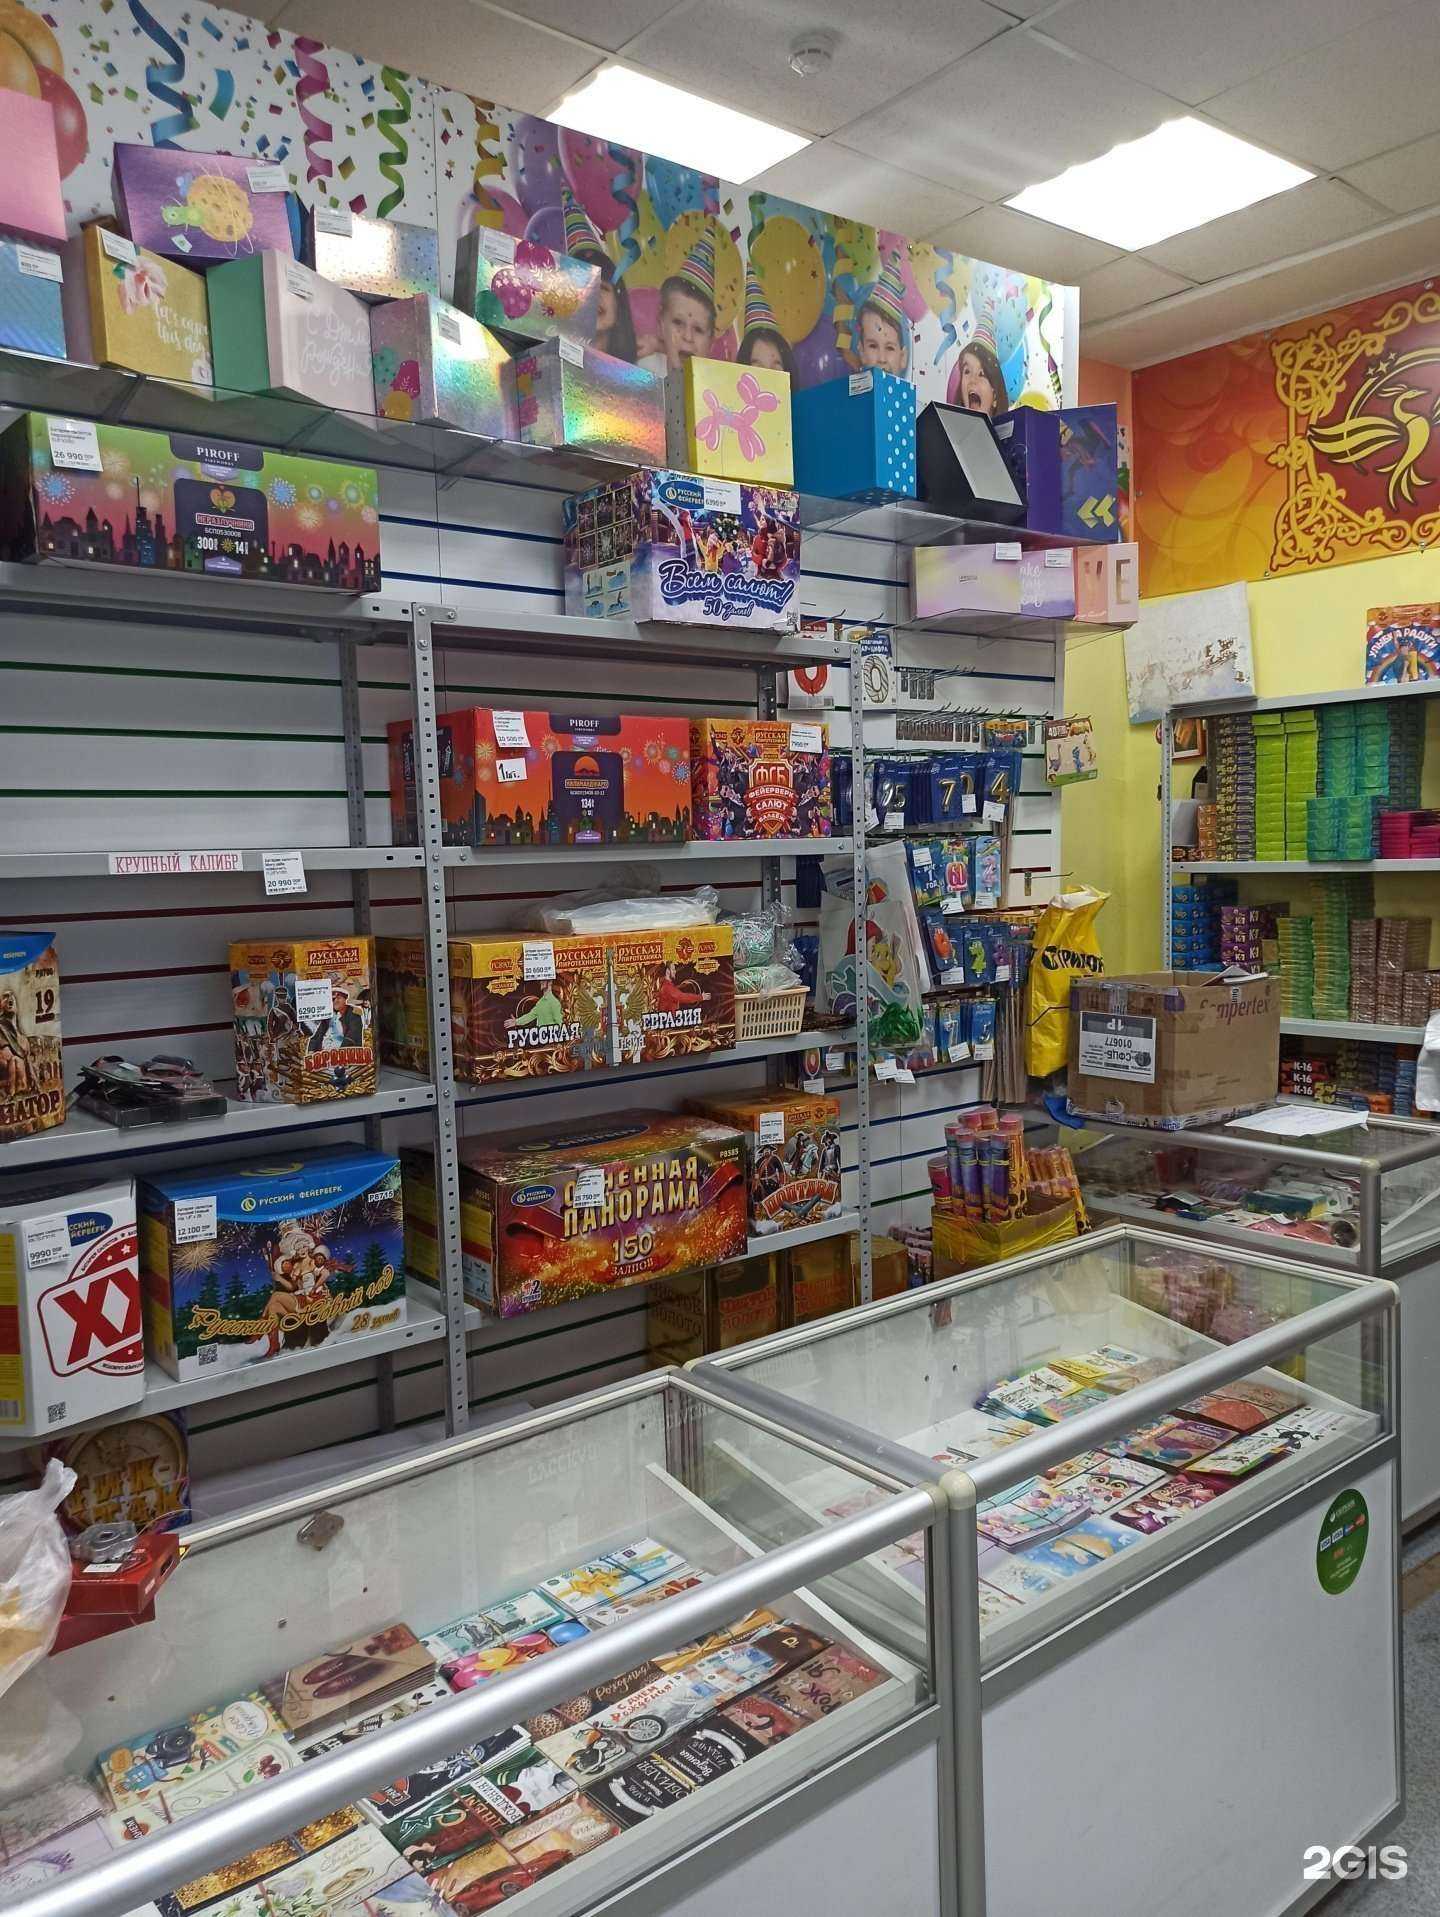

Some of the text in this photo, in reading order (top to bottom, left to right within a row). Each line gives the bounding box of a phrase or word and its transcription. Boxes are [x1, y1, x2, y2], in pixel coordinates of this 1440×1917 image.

[196, 446, 240, 461] PIROFF
[197, 536, 213, 551] 300
[660, 562, 794, 606] Всем салют!
[703, 597, 721, 617] 50
[1403, 628, 1439, 650] РАДУГИ
[569, 719, 600, 728] PIROFF
[748, 786, 795, 799] ФЕЙЕРВЕРК
[755, 801, 789, 811] САЛЮТ
[116, 852, 239, 873] КРУПНЫЙ КАЛИБР
[309, 948, 358, 963] РУССКАЯ
[557, 949, 601, 962] РУССКАЯ
[618, 946, 662, 959] РУССКАЯ
[558, 959, 602, 968] ПИРОТЕХНИКА
[35, 988, 55, 1014] 19
[641, 1007, 702, 1032] ЕВРАЗИЯ
[508, 1021, 582, 1049] РУССКАЯ
[1104, 1036, 1132, 1048] 010677
[564, 1155, 699, 1207] ОНЕННАЯ
[258, 1184, 343, 1207] РУССКИЙ ФЕЙЕРВЕРК
[563, 1178, 701, 1239] ПАНОРАМА
[69, 1218, 96, 1231] ССКИЙ
[187, 1225, 201, 1235] 100
[29, 1248, 52, 1261] 9990
[611, 1232, 654, 1264] 150
[611, 1259, 654, 1277] ЗАЛПОВ
[351, 1312, 370, 1331] 28
